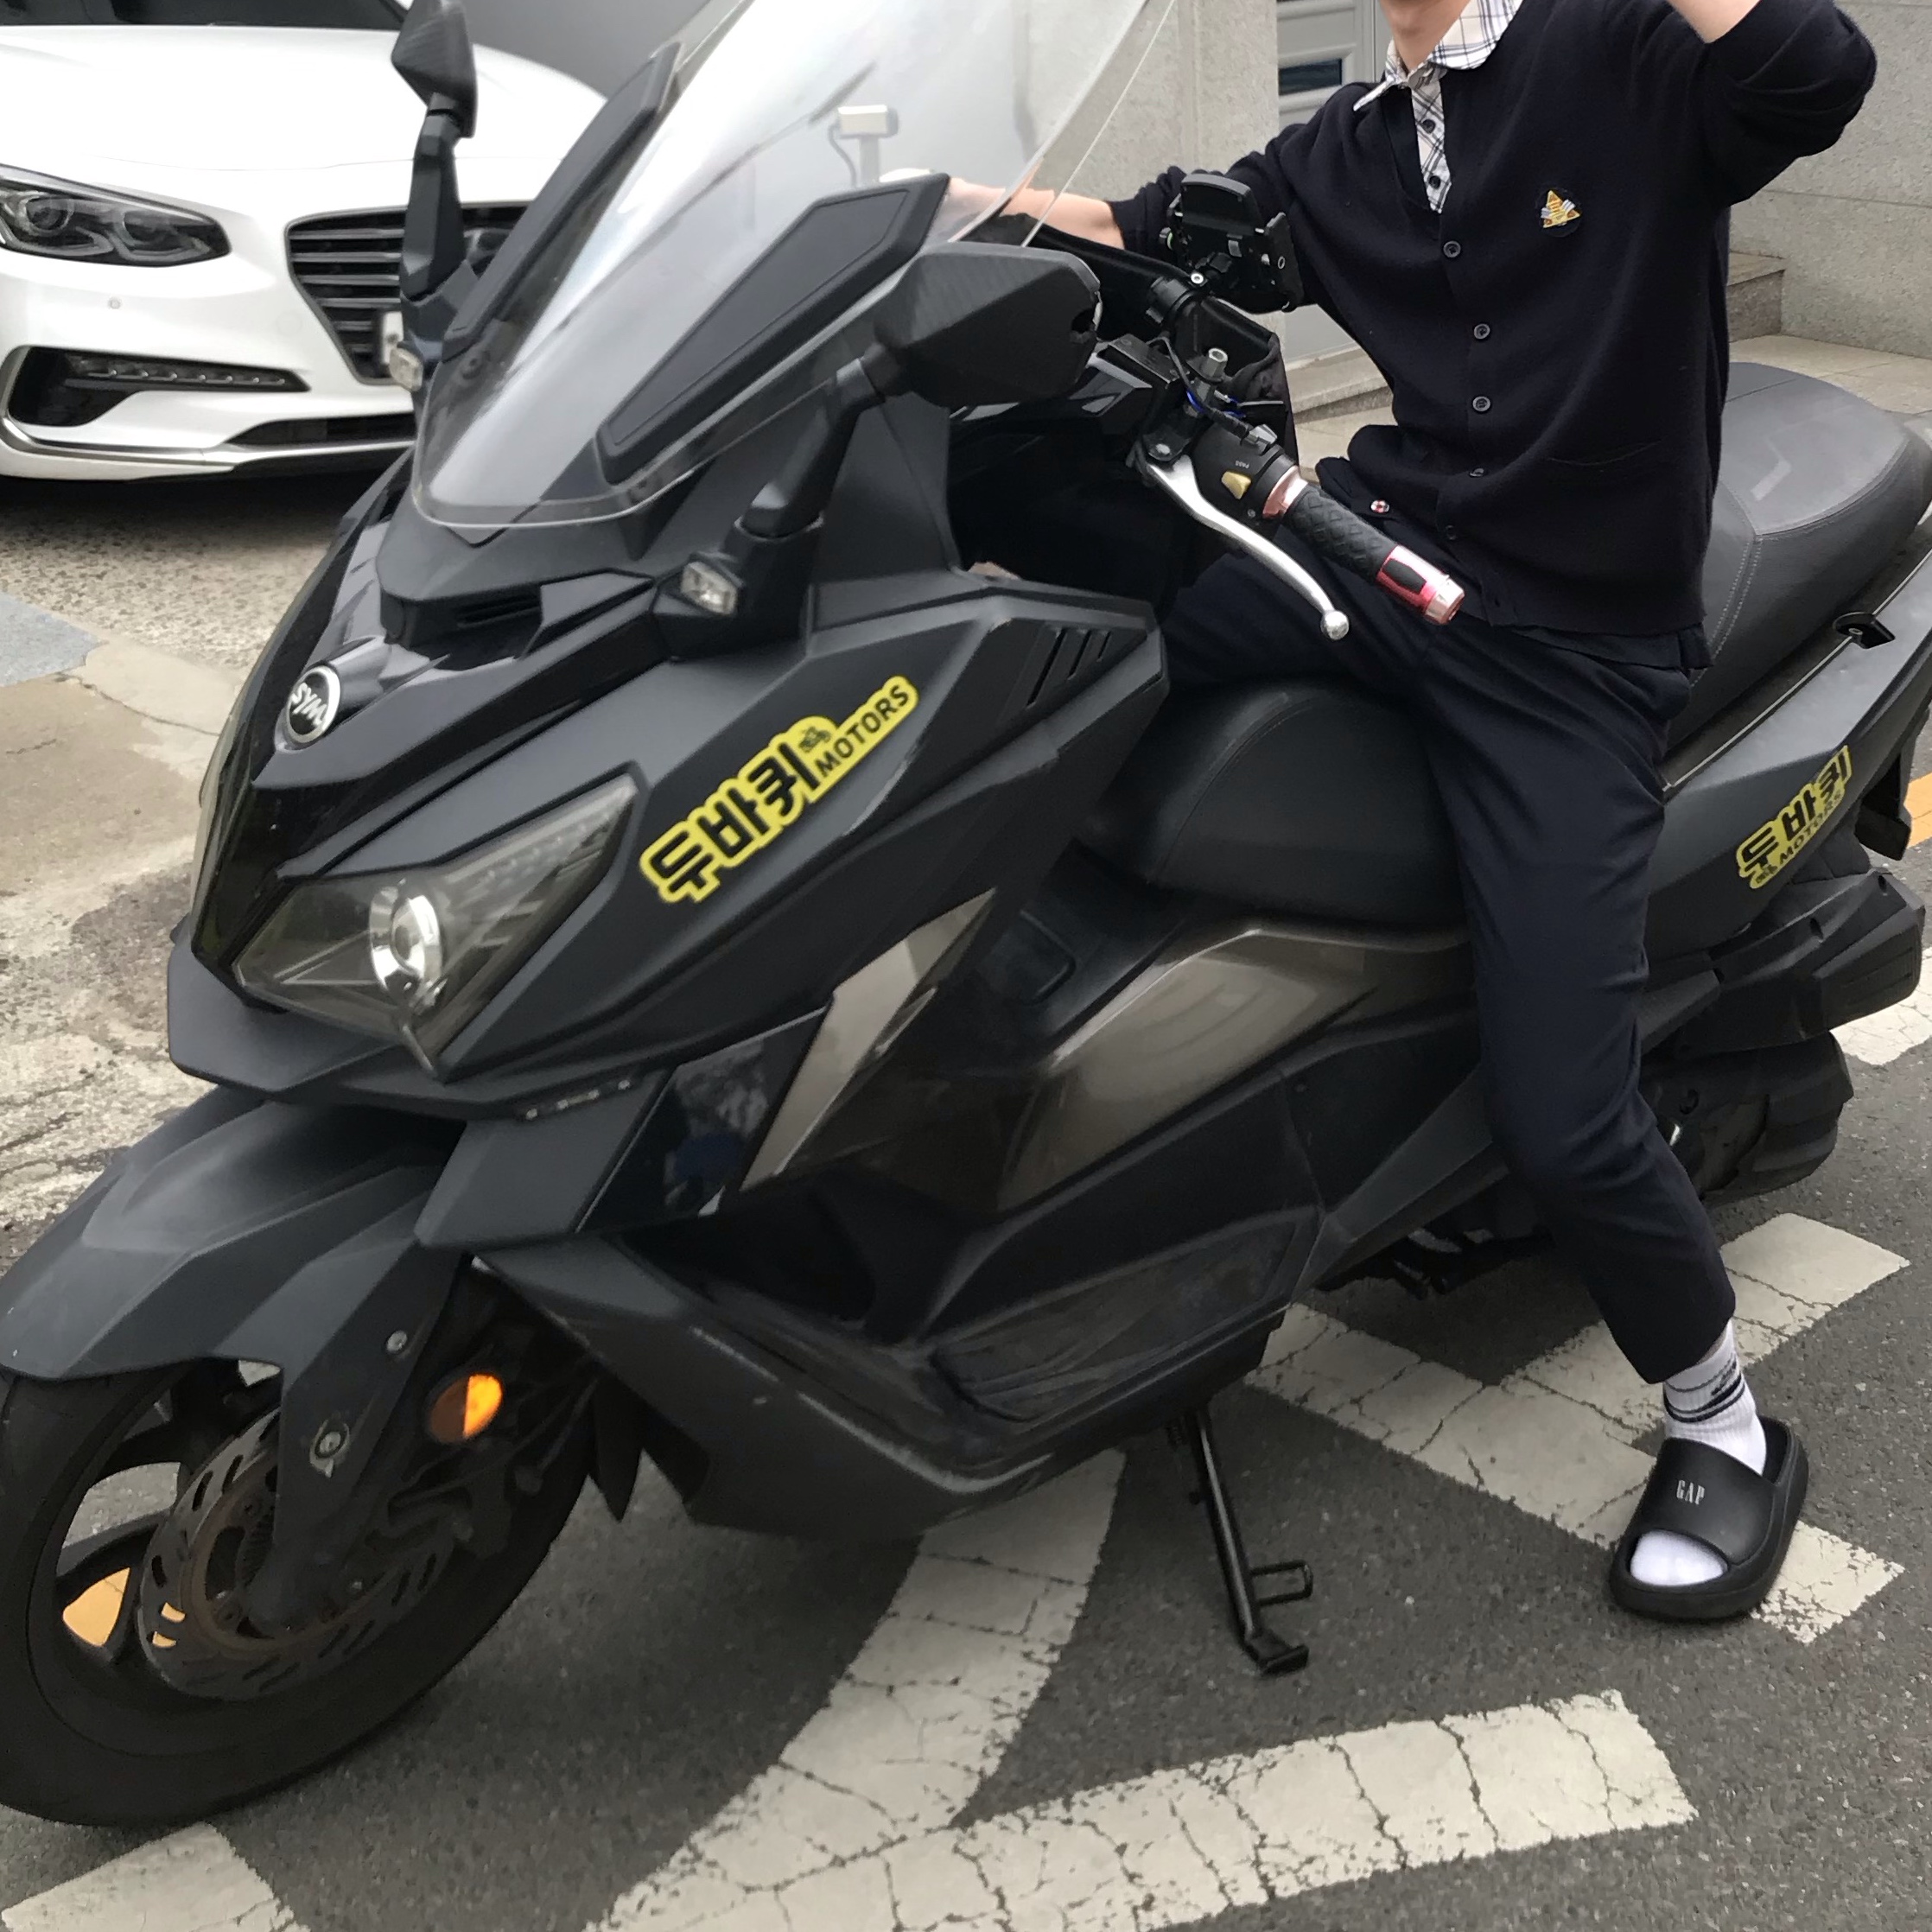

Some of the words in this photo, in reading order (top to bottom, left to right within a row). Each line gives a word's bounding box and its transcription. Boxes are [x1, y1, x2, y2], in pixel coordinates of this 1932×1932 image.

[289, 682, 327, 726] SYM
[648, 741, 821, 894] 두바퀴
[814, 683, 910, 777] MOTORS
[1741, 752, 1847, 872] 두바퀴
[1676, 1479, 1706, 1505] GAP
